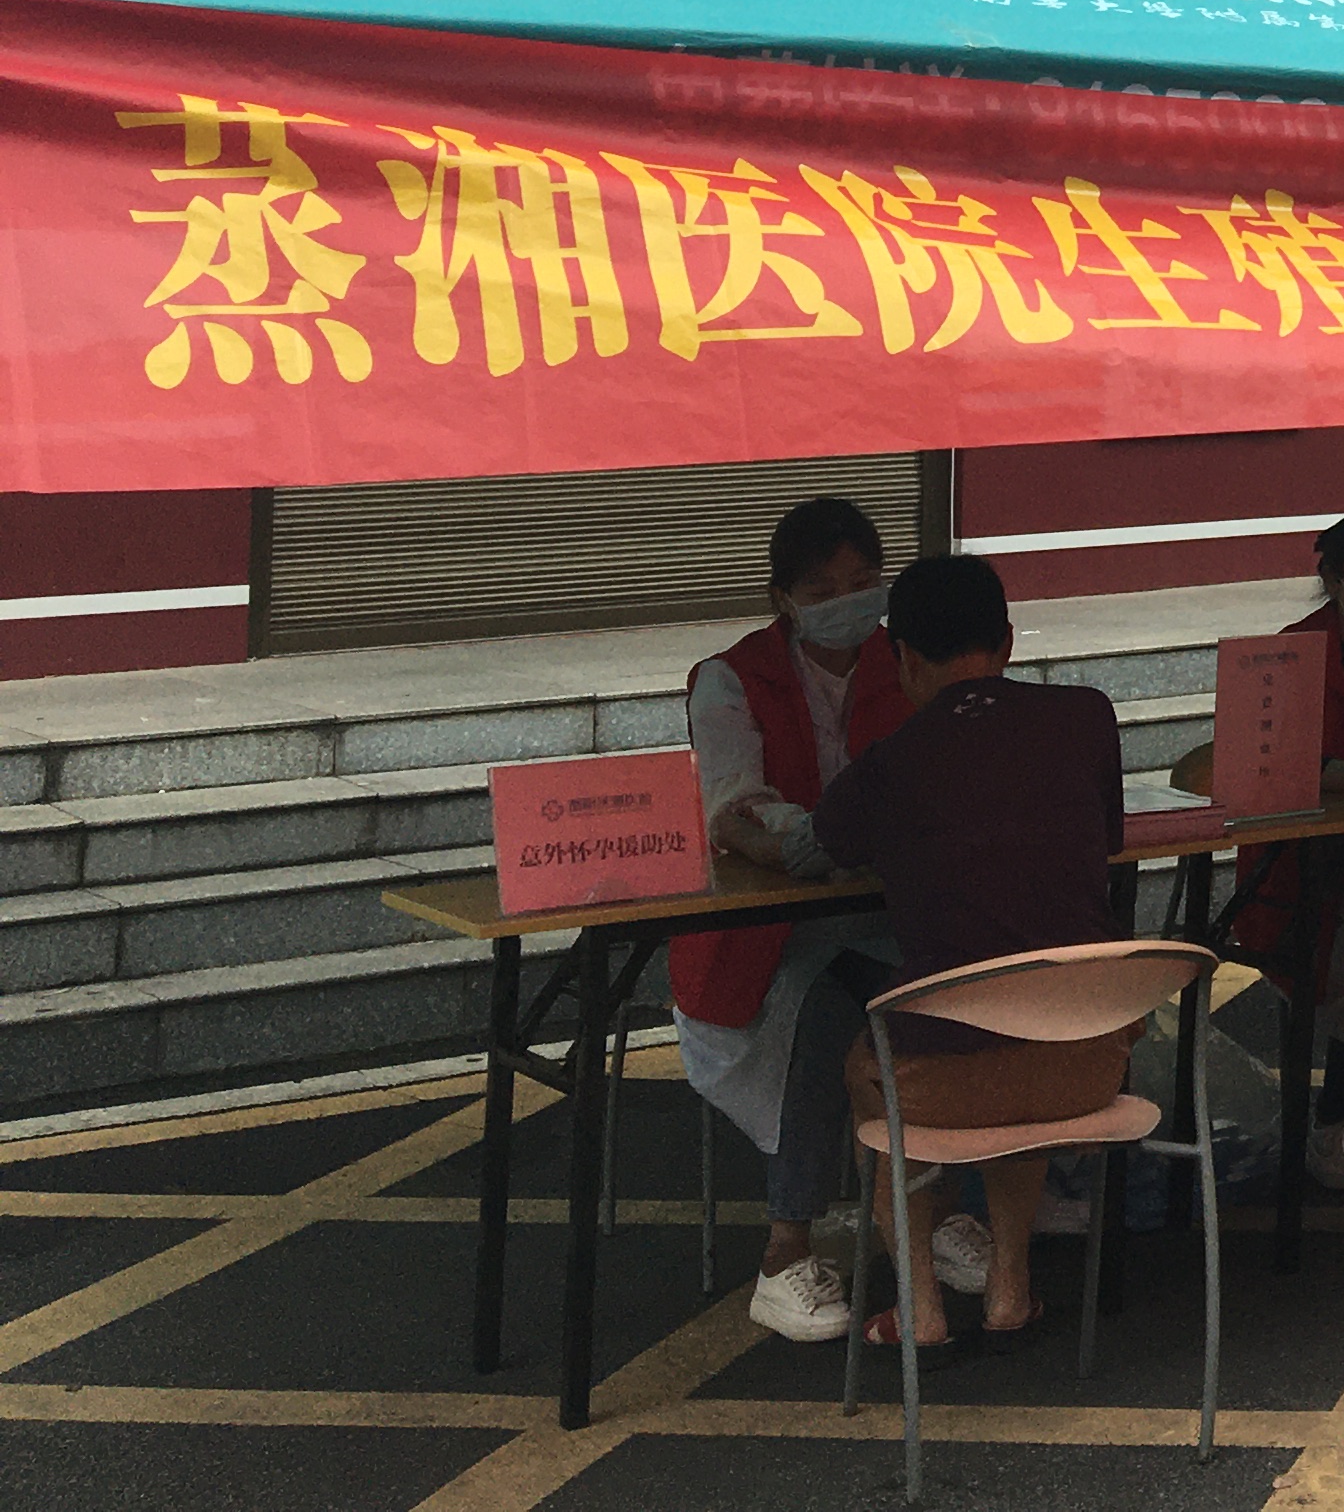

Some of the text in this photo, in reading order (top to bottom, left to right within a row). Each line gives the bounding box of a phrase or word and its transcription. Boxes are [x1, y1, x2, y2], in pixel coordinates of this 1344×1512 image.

[518, 830, 688, 868] 意外怀孕援助处
